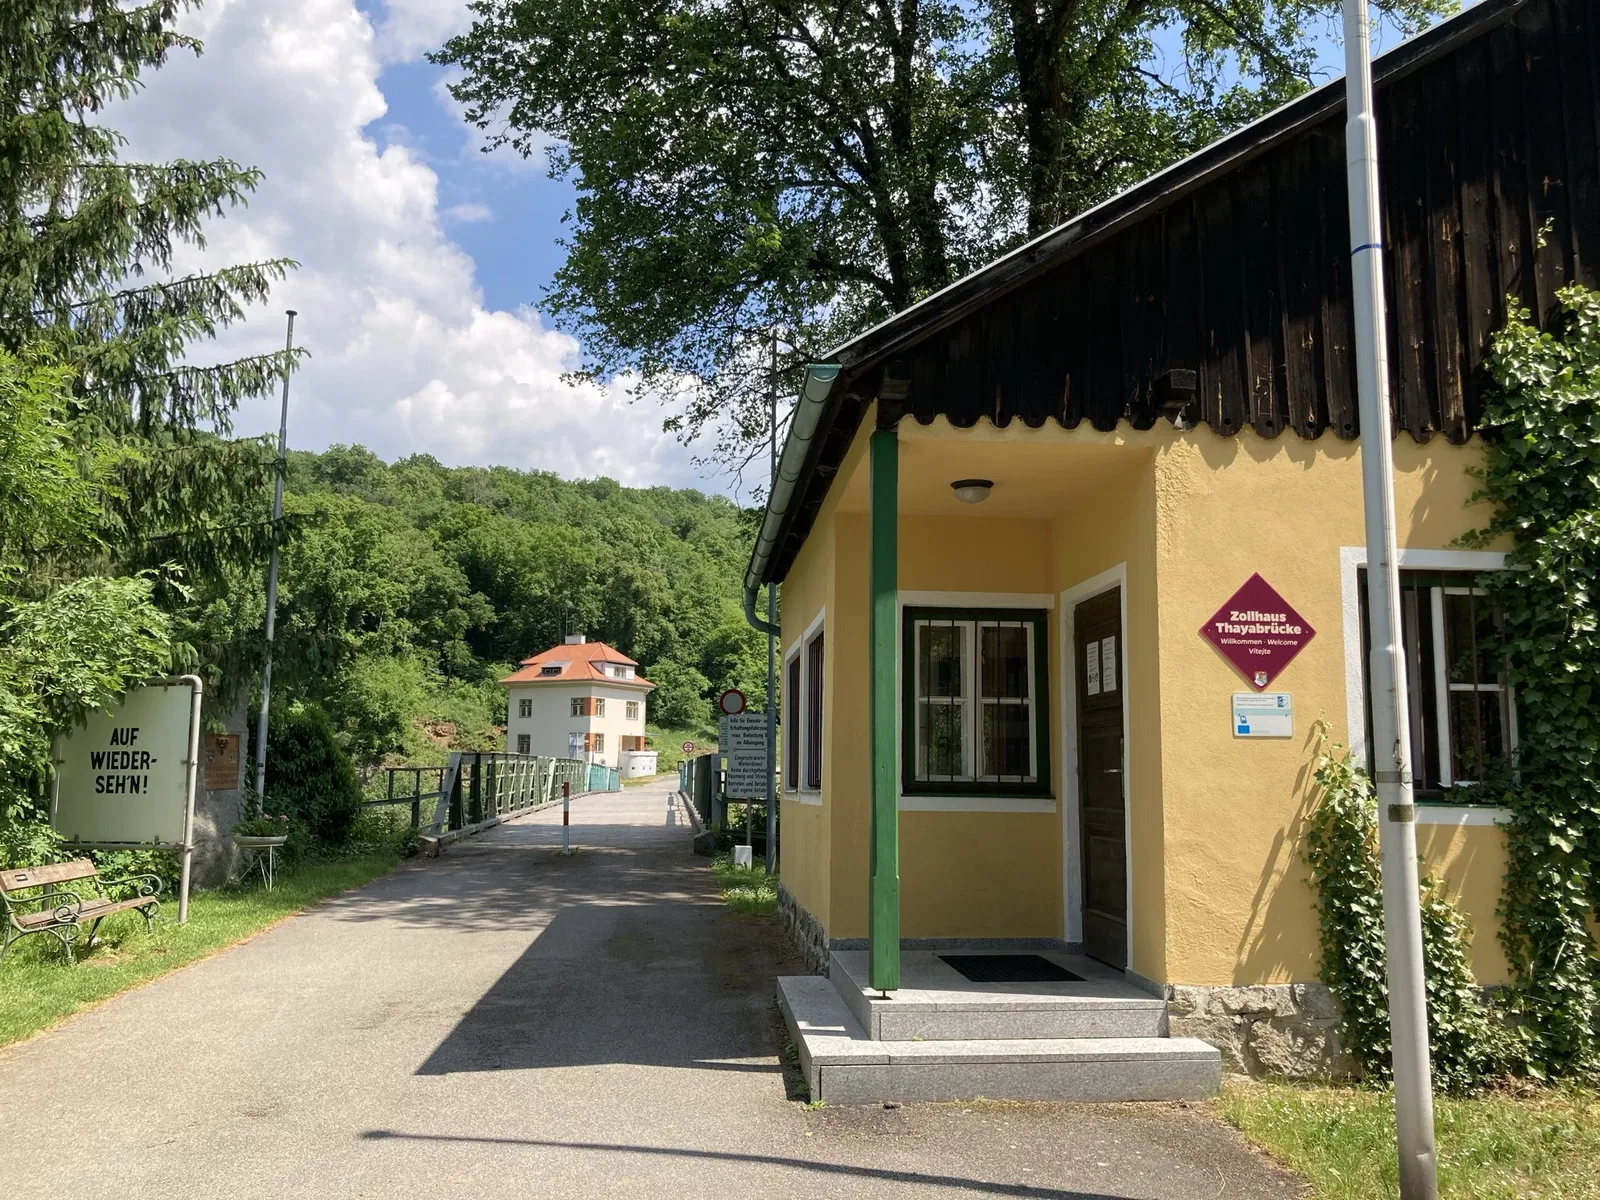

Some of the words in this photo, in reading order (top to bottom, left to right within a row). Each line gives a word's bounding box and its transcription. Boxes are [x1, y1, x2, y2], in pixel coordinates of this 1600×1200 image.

[1230, 611, 1287, 622] Zollhaus
[1215, 622, 1302, 636] Thayabrücke
[1220, 638, 1263, 646] Willkommen
[109, 727, 140, 746] AUF
[90, 751, 158, 770] WIEDER-
